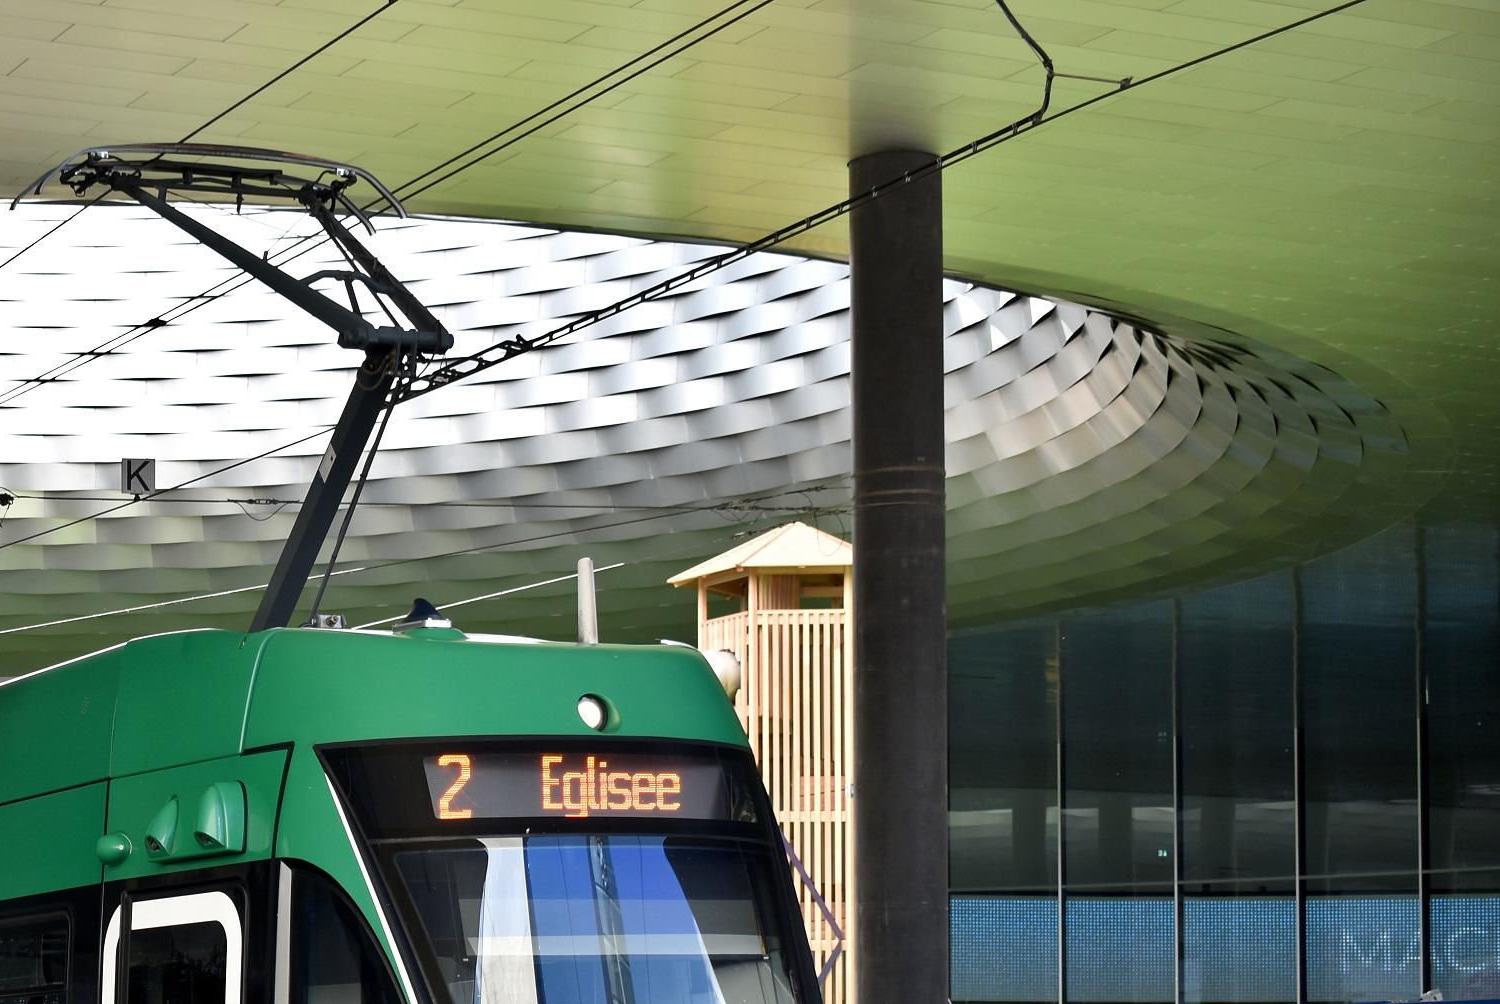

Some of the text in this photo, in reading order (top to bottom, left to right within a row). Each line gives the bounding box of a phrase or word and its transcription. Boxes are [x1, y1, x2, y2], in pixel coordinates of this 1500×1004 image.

[126, 460, 150, 491] K
[438, 755, 681, 819] 2 Eglisee
